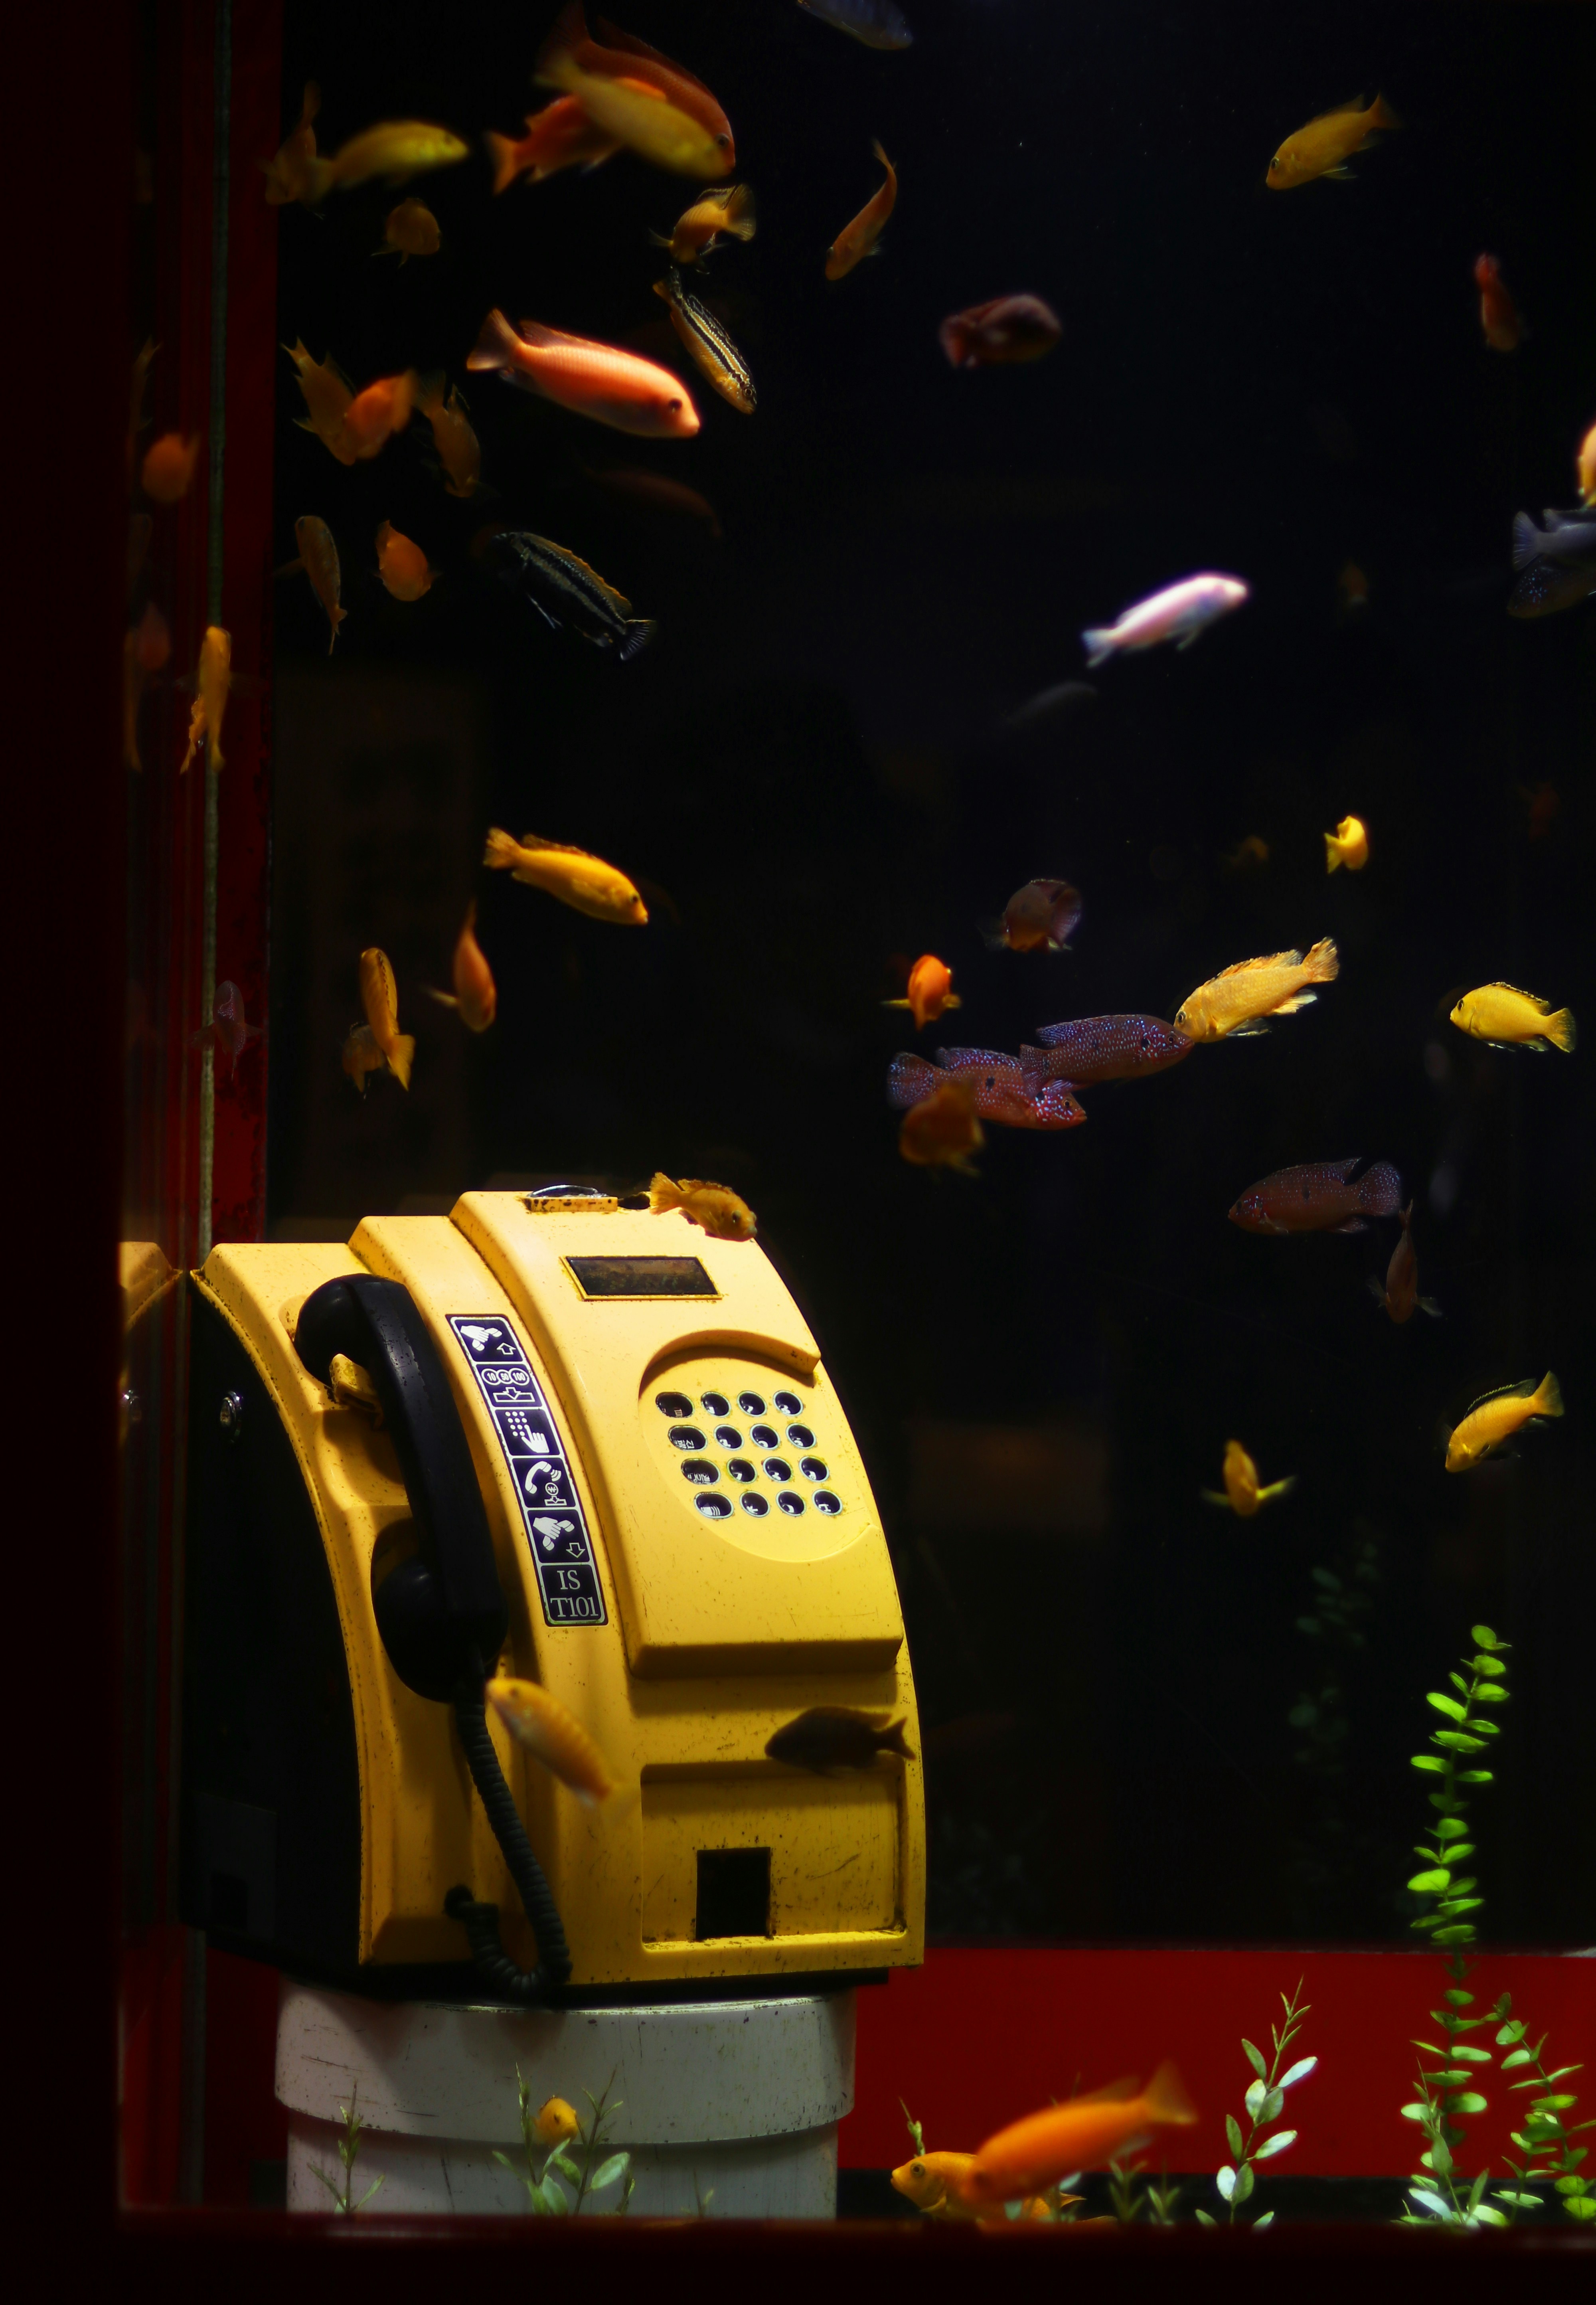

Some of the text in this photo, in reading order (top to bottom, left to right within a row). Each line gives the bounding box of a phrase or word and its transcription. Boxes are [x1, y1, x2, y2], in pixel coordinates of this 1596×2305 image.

[487, 1372, 496, 1381] 10
[512, 1372, 525, 1381] 100
[557, 1570, 581, 1590] IS
[550, 1597, 598, 1617] T101
